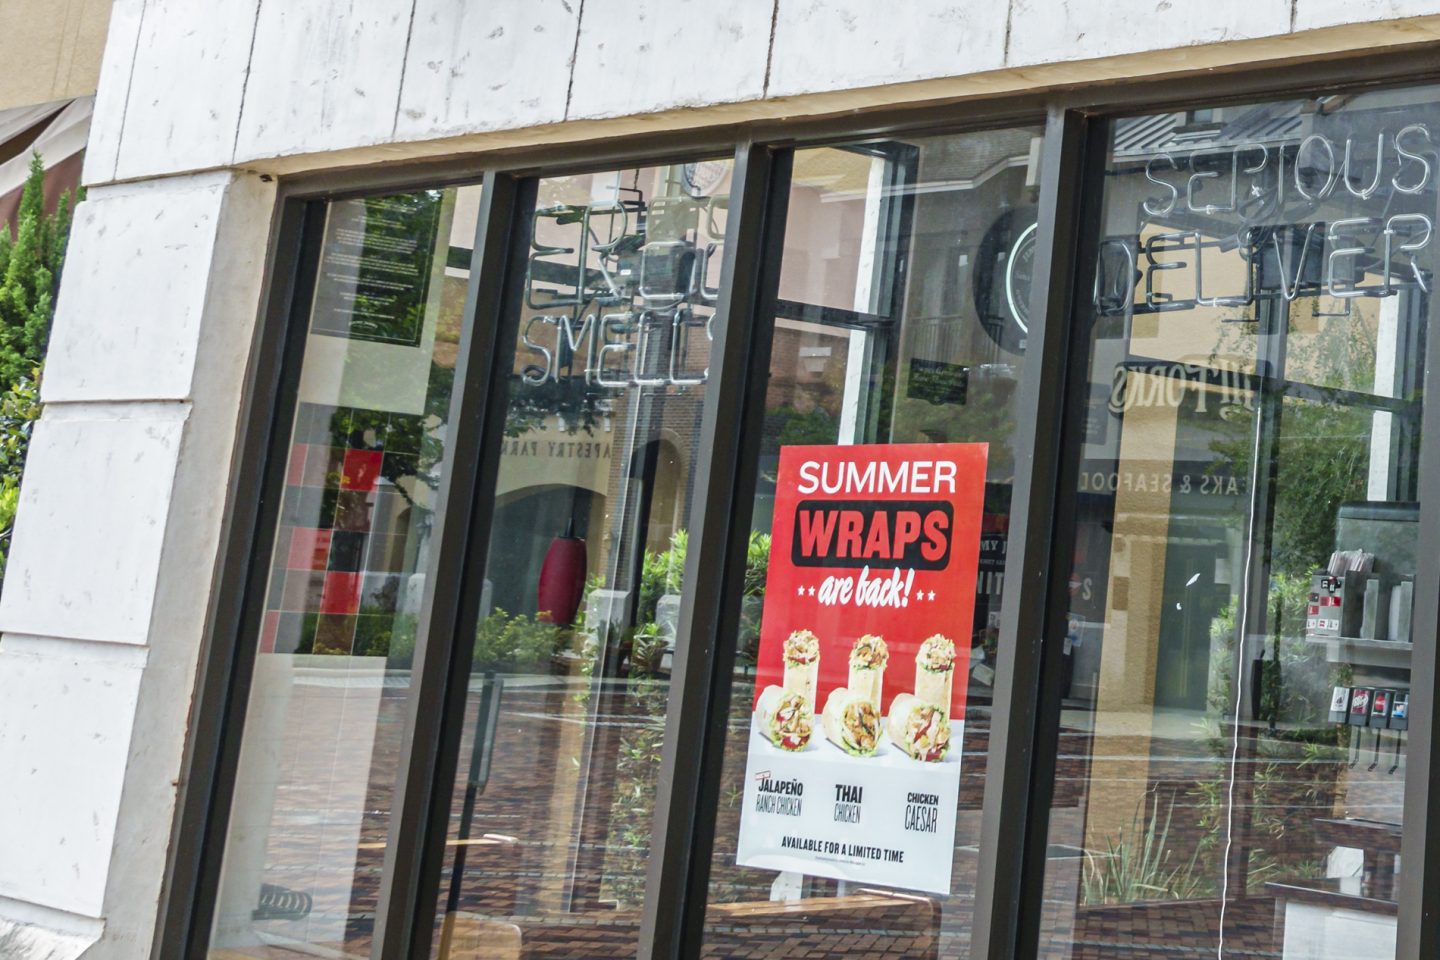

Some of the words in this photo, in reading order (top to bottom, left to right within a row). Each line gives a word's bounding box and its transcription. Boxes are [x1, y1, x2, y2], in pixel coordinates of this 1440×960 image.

[1142, 123, 1432, 216] SERIOUS
[521, 311, 715, 387] SMELL
[797, 460, 958, 494] SUMMER
[799, 509, 950, 561] WRAPS
[818, 576, 854, 606] are
[855, 565, 915, 608] back!
[758, 776, 804, 797] JALAPEÑO
[835, 784, 863, 804] THAI
[907, 792, 939, 806] CHICKEN
[755, 794, 776, 814] RANCH
[776, 795, 802, 817] CHICKEN
[833, 803, 861, 824] CHICKEN
[904, 804, 938, 833] CAESAR
[781, 835, 823, 853] AVAILABLE
[824, 841, 840, 855] FOR
[841, 843, 847, 856] A
[848, 844, 882, 861] LIMITED
[883, 849, 904, 864] TIME
